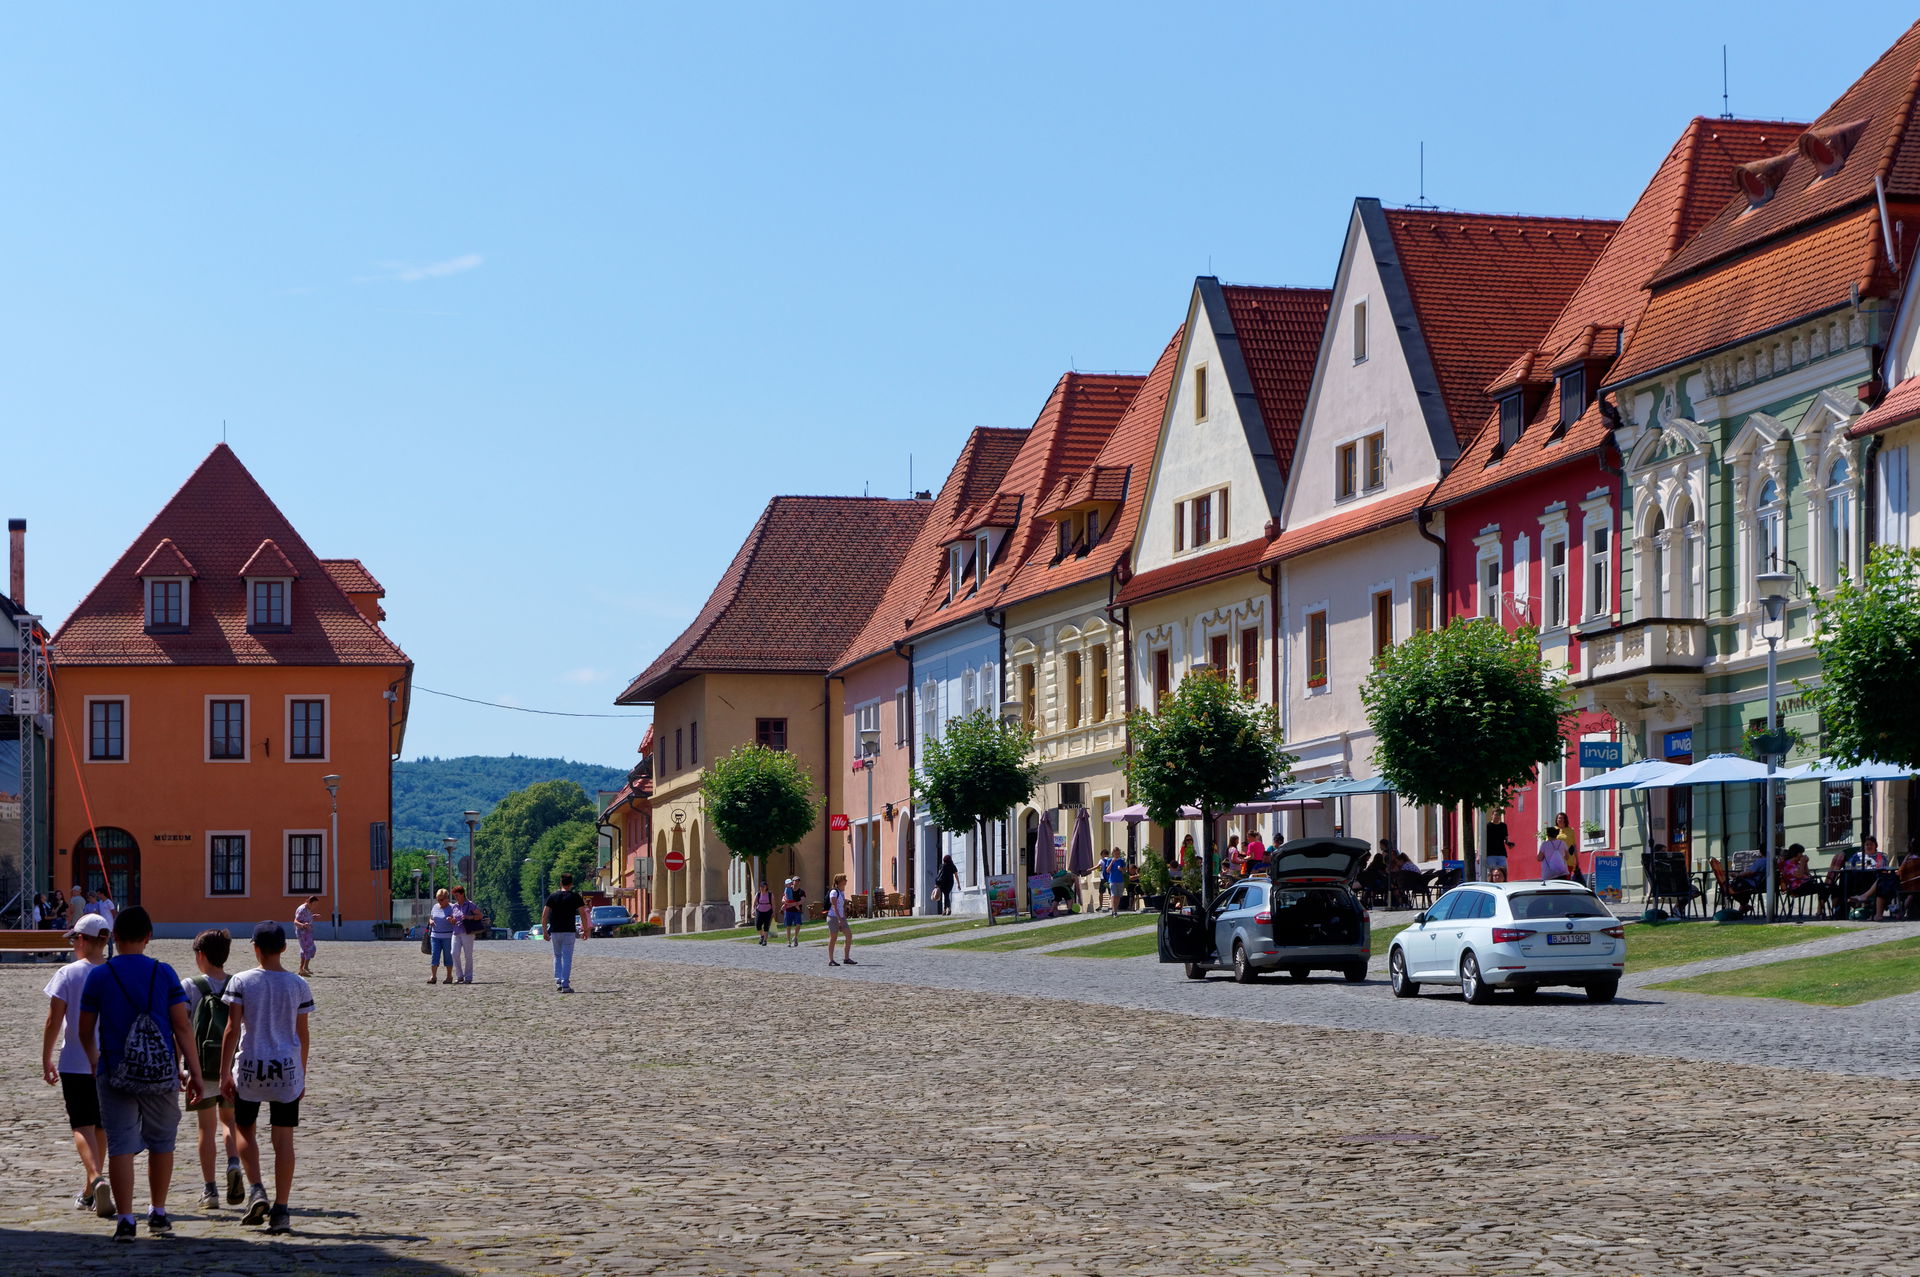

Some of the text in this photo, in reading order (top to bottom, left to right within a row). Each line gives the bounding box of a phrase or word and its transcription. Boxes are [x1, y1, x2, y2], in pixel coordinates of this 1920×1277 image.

[1671, 734, 1692, 752] invia
[1585, 745, 1618, 760] invia
[832, 816, 847, 828] illy
[1598, 858, 1617, 867] invia
[256, 1059, 283, 1081] LA
